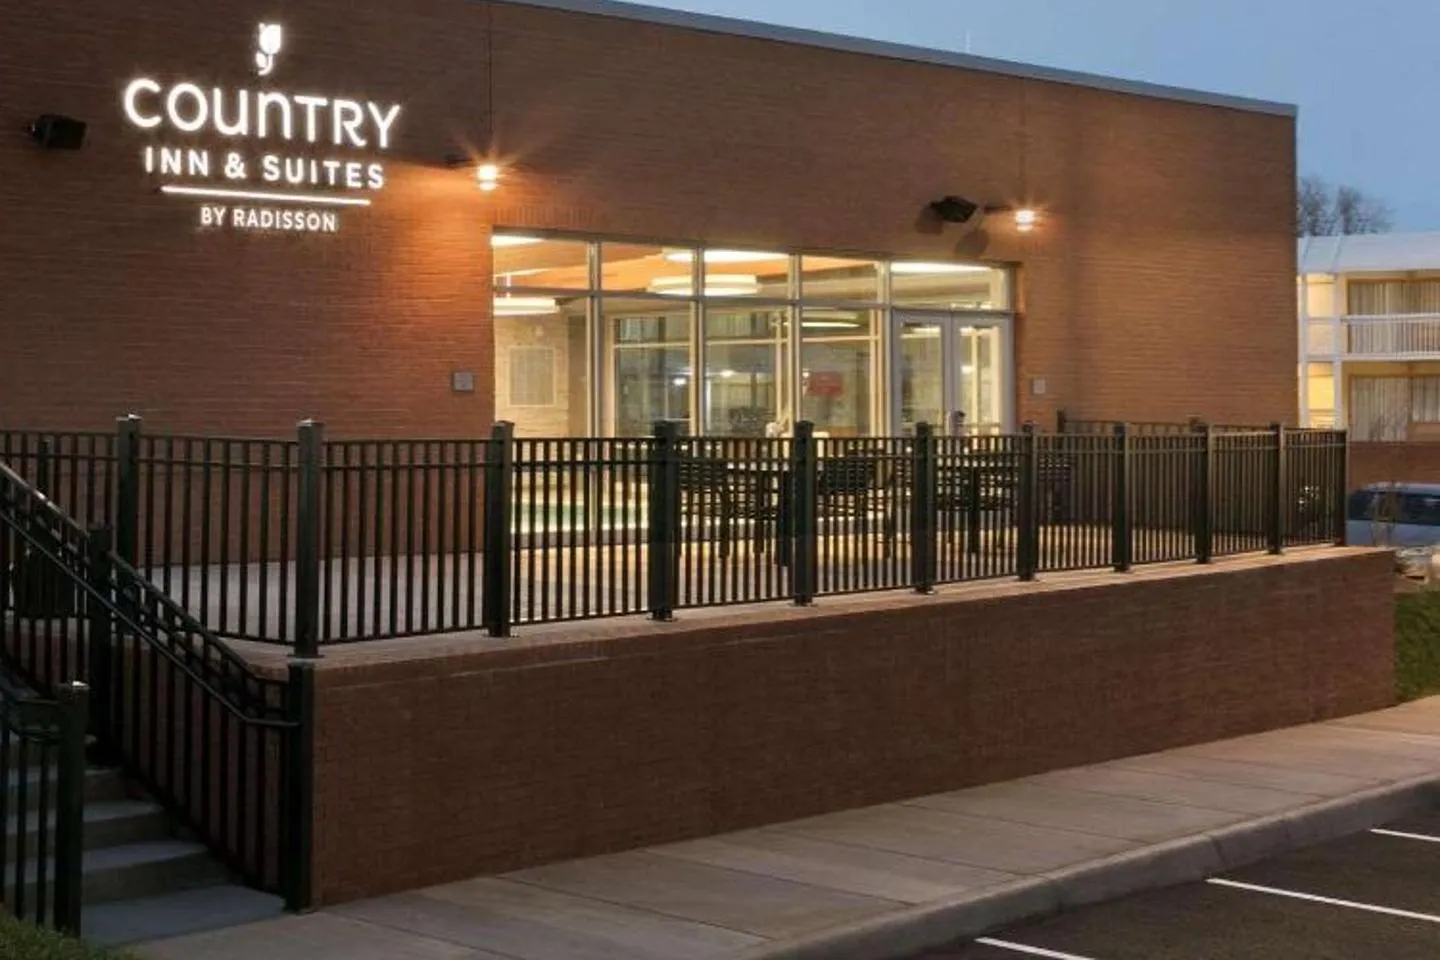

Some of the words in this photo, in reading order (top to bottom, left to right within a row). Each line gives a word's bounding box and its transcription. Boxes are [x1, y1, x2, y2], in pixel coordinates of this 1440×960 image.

[145, 146, 210, 176] INN
[224, 154, 247, 179] &
[262, 154, 384, 189] SUITES
[200, 206, 226, 226] BY
[233, 208, 337, 232] RADISSON
